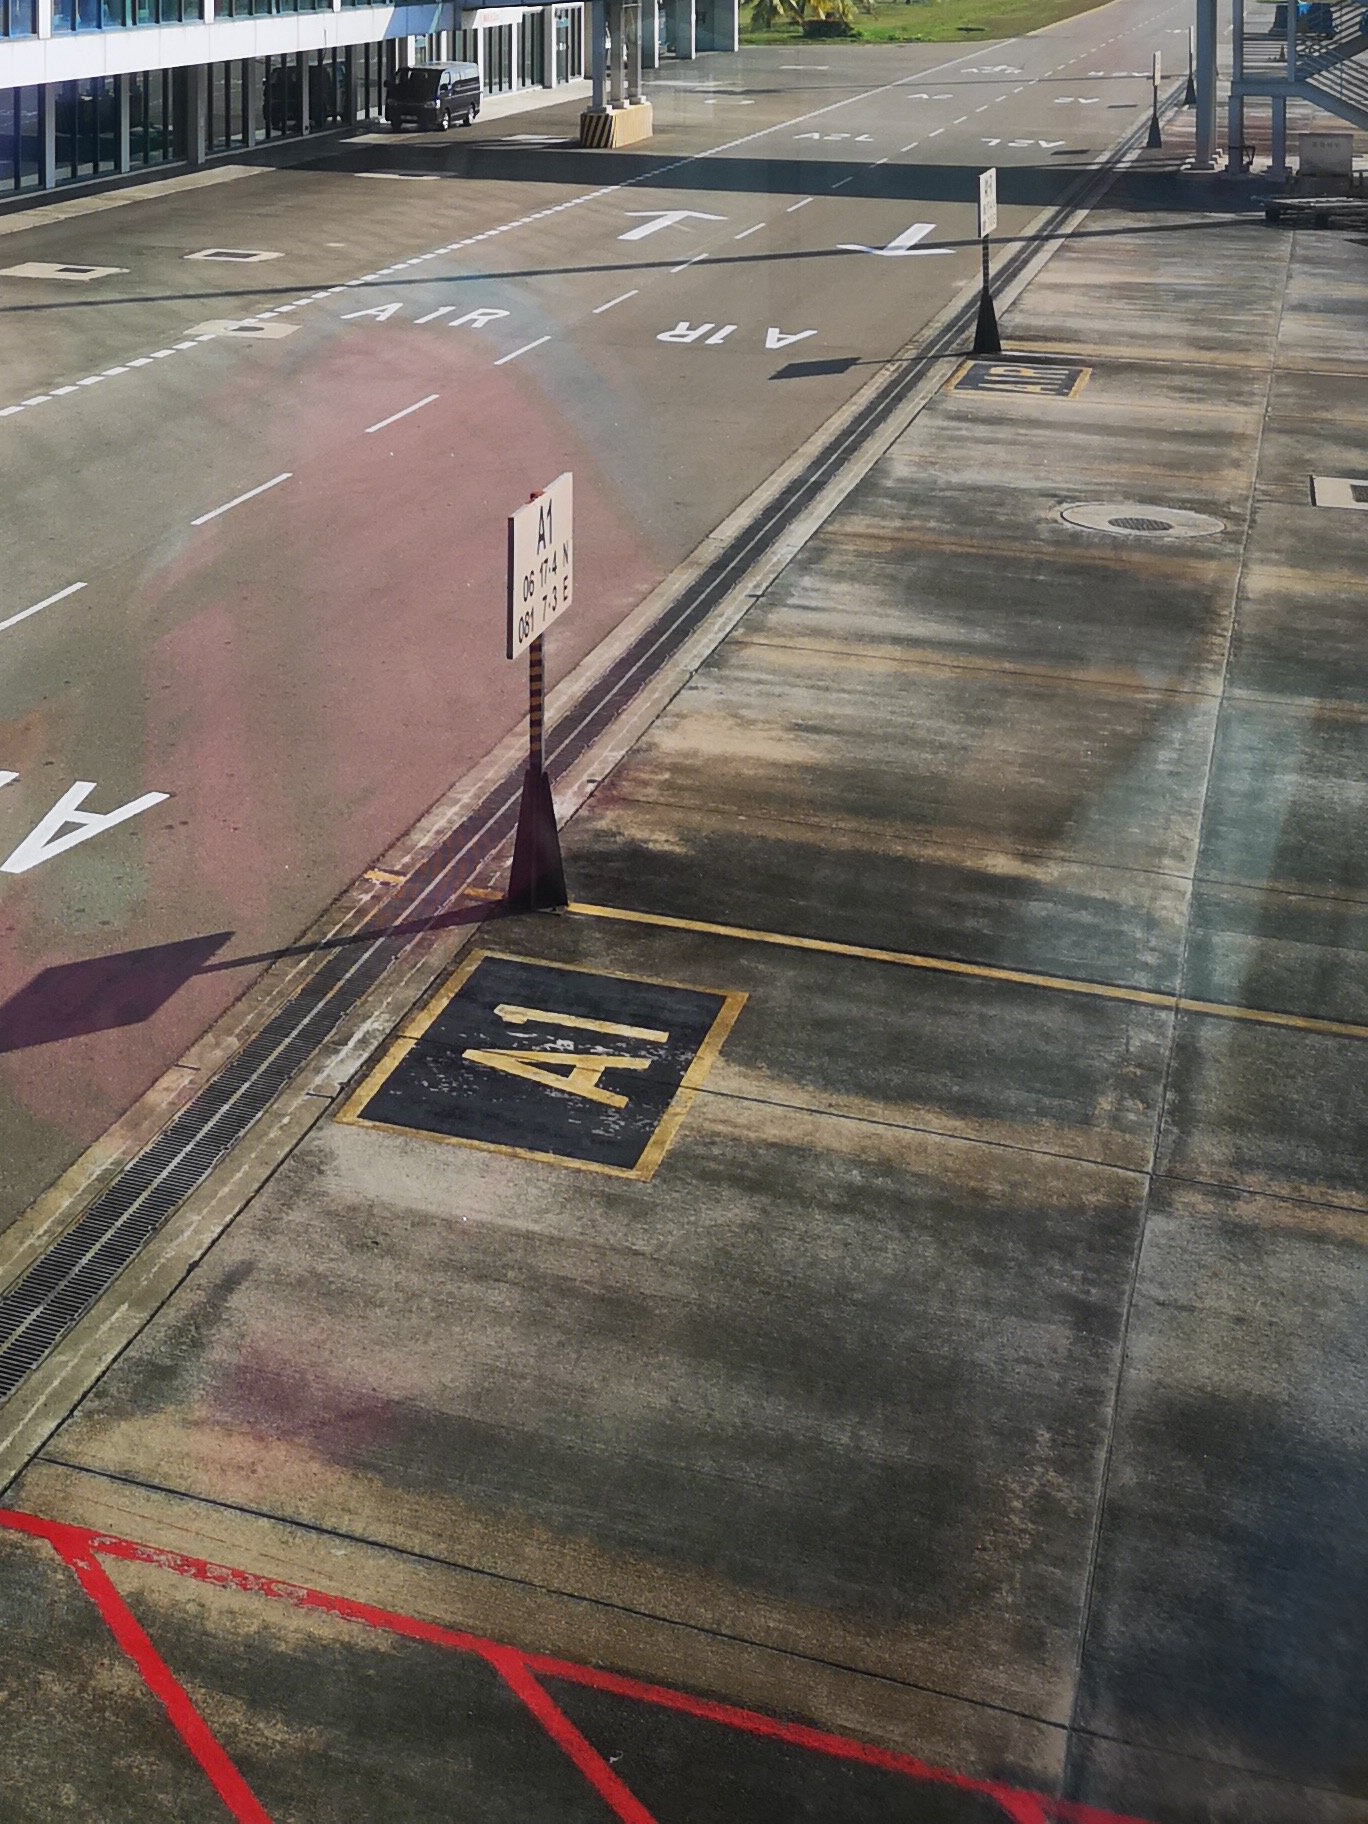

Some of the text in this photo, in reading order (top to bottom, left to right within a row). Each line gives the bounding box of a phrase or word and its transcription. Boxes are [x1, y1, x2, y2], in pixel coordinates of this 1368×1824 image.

[536, 498, 553, 556] A1
[523, 569, 535, 603] 06
[562, 539, 569, 567] N
[518, 605, 534, 644] 081
[562, 574, 569, 602] E
[461, 1003, 670, 1110] A1
